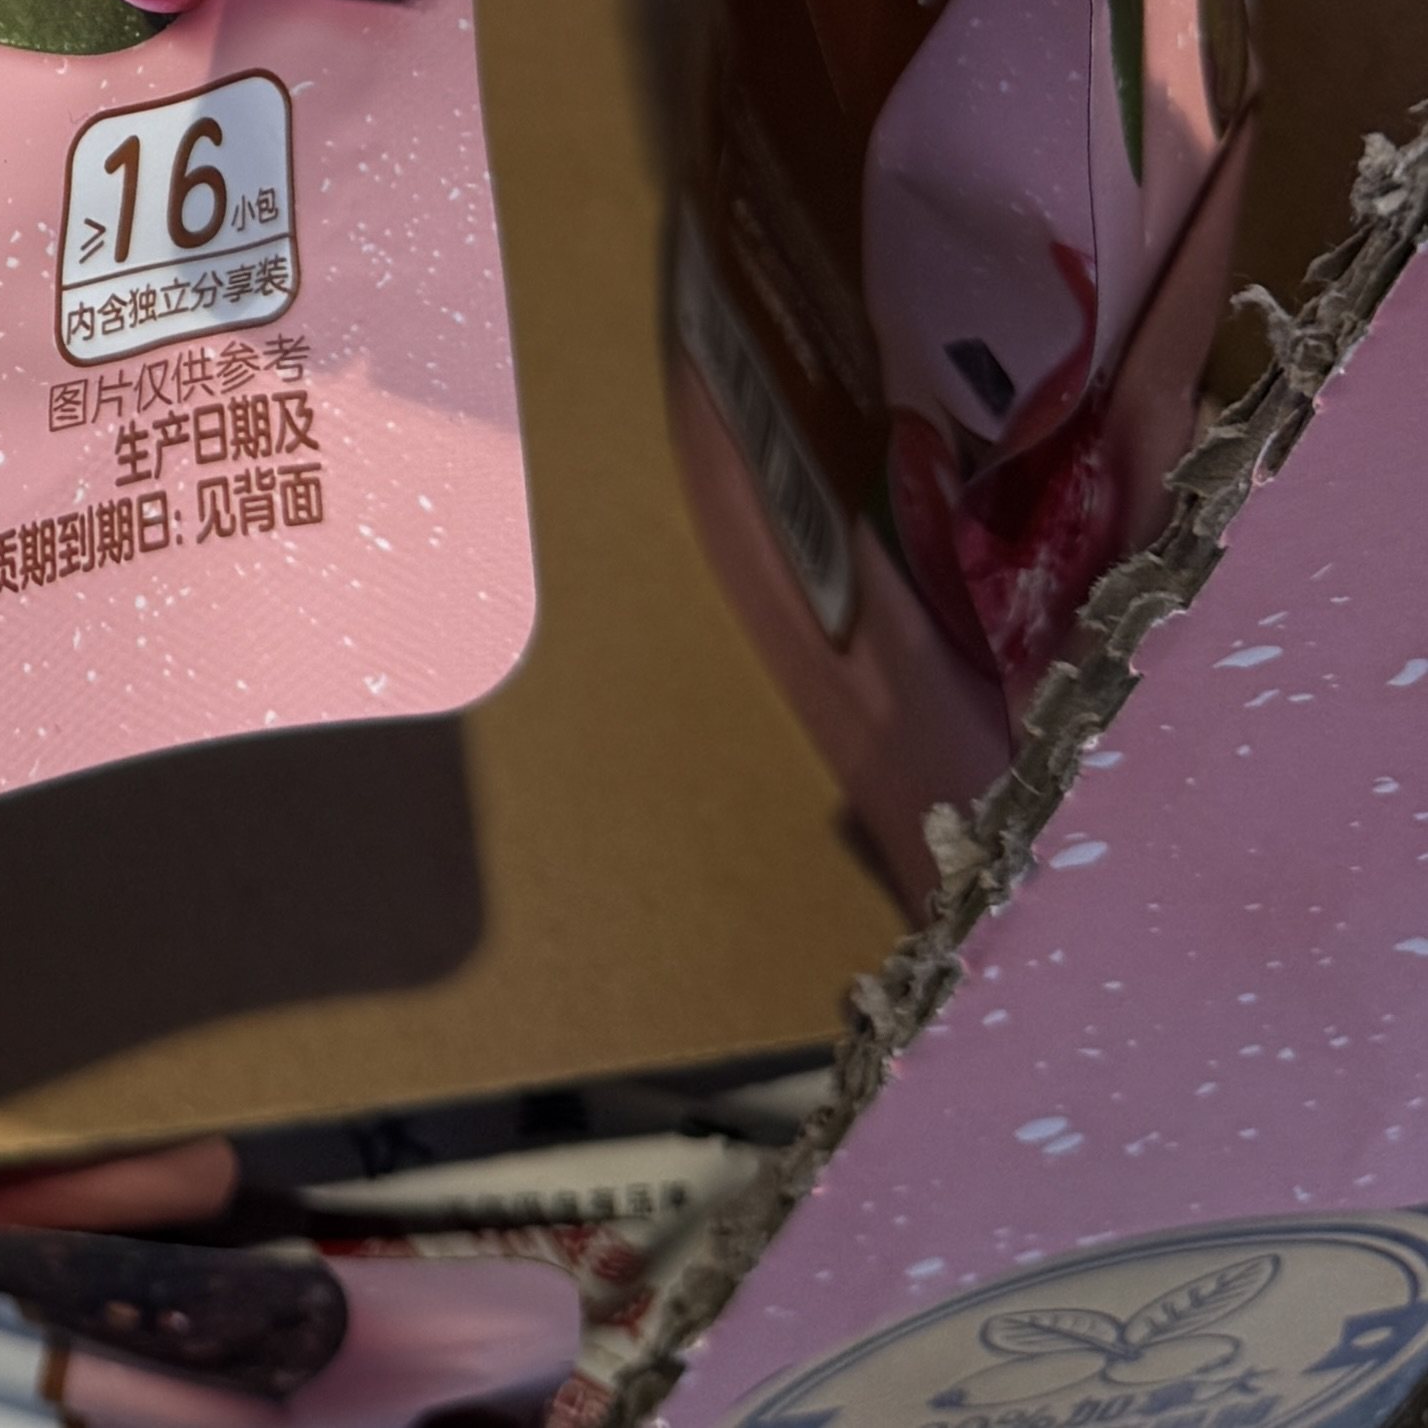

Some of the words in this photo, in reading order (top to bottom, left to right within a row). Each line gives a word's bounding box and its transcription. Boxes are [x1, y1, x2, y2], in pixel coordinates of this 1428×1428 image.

[66, 255, 292, 344] 内含独立分享装
[49, 332, 311, 432] 图片仅供参考
[114, 389, 320, 487] 生产日期及
